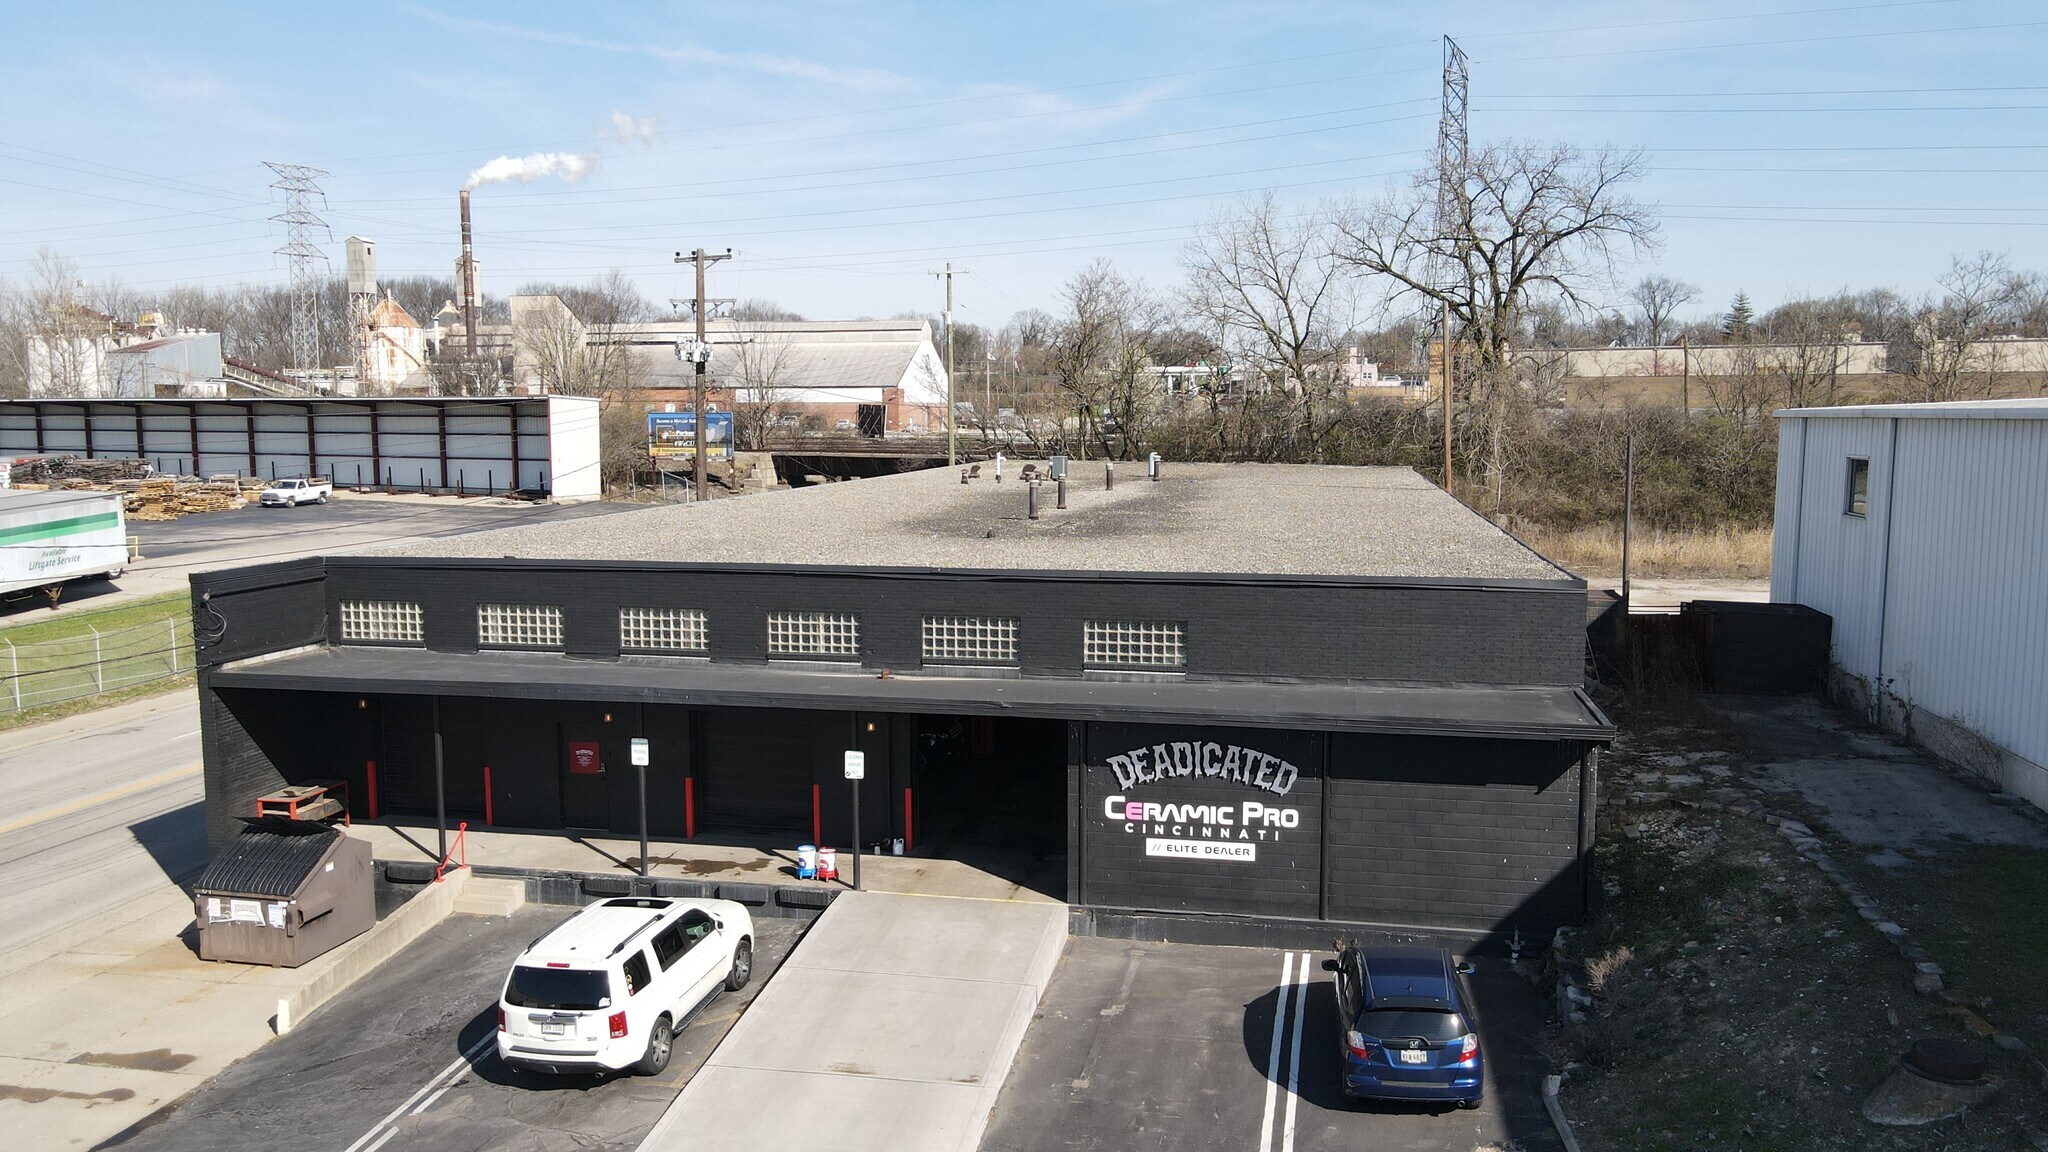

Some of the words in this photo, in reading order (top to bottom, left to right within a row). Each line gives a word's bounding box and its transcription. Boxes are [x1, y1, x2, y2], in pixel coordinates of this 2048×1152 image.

[41, 547, 67, 558] Available
[28, 557, 56, 571] Liftgate
[56, 554, 81, 565] Service
[1106, 741, 1298, 797] DEADICATED
[1104, 795, 1234, 825] CERAMIC
[1242, 801, 1299, 828] PRO
[1124, 822, 1279, 842] CINCINNATI
[1166, 844, 1198, 854] ELITE
[1205, 846, 1250, 856] DEALER
